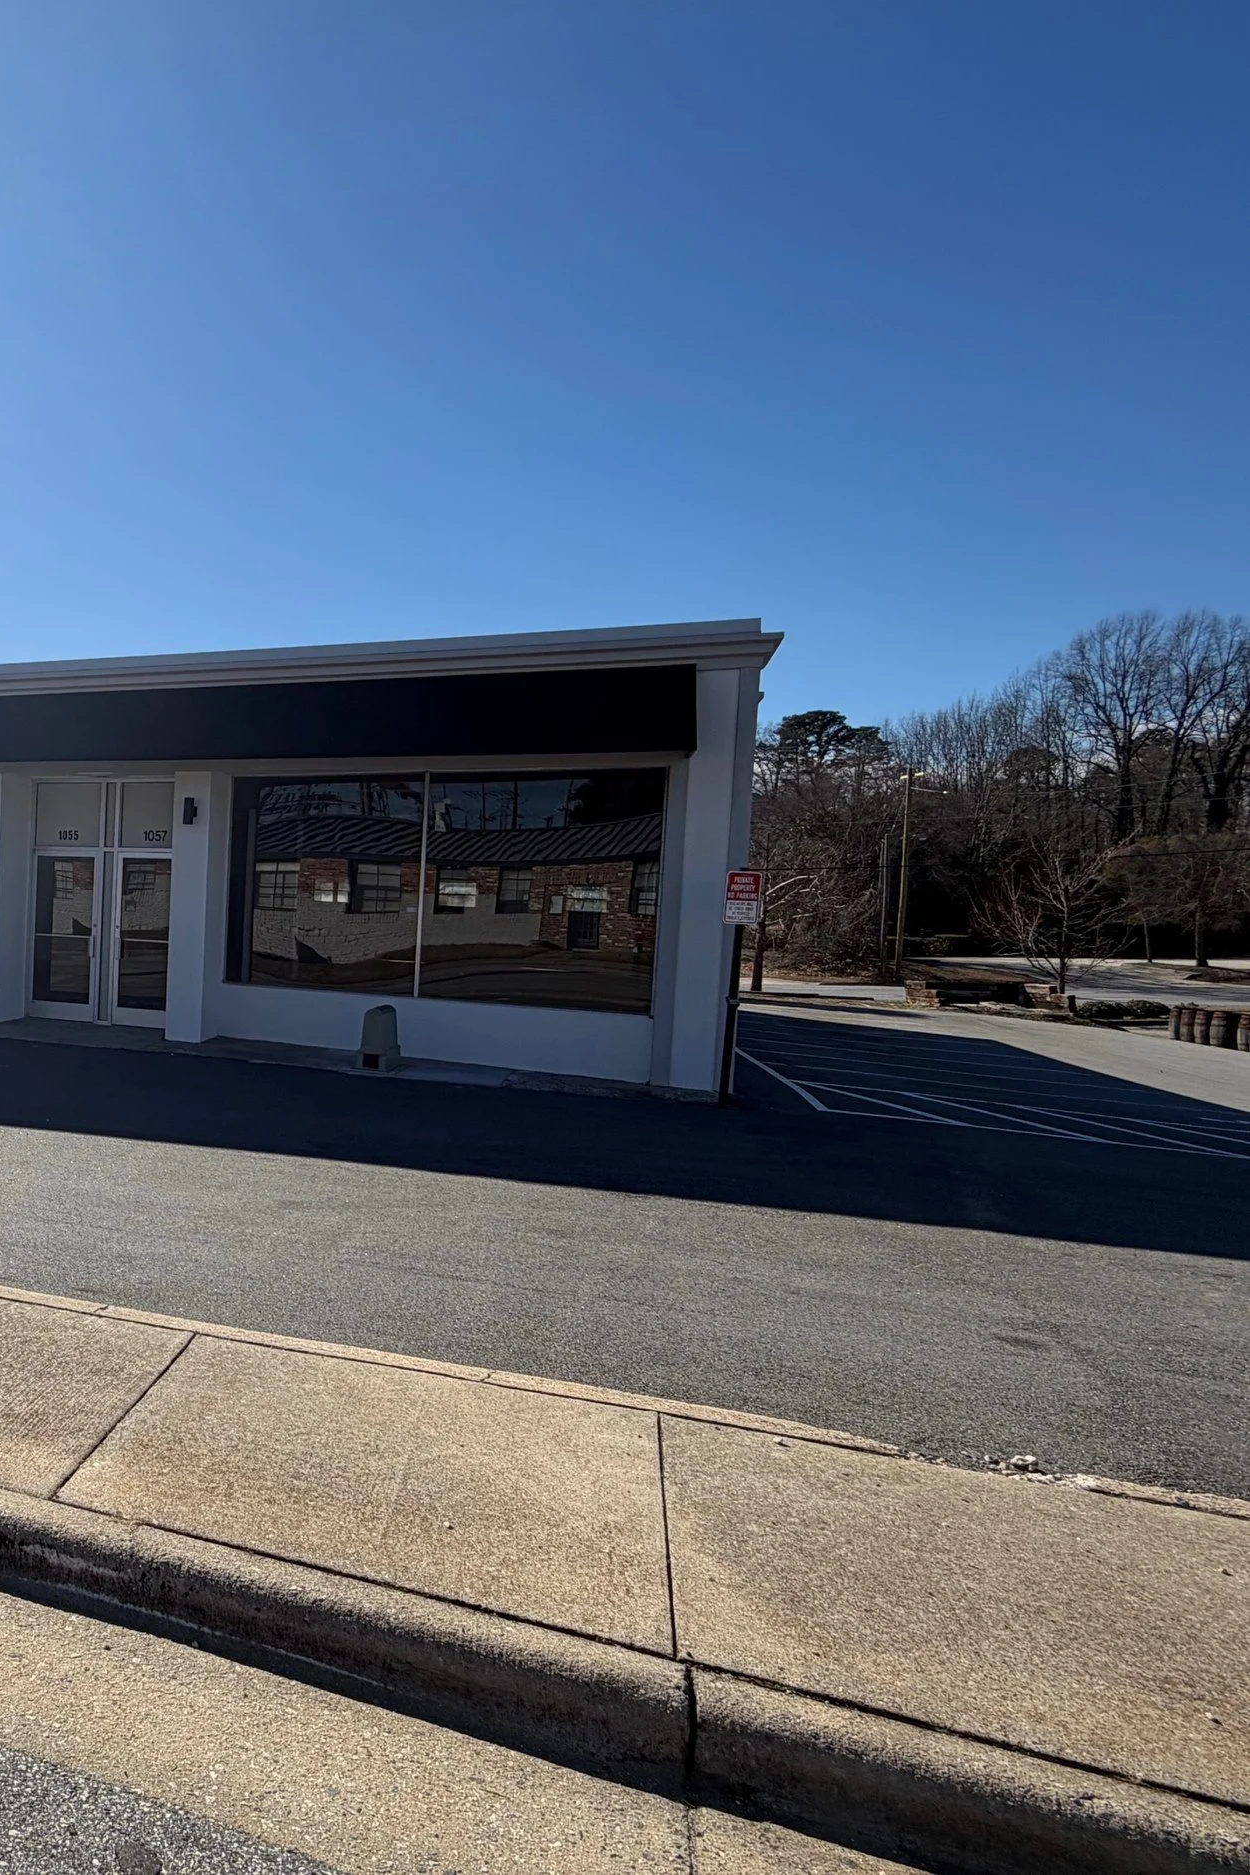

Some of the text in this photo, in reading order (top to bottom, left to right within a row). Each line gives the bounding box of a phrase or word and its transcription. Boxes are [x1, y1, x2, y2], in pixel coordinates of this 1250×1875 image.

[58, 830, 79, 841] 1055
[143, 830, 168, 842] 1057
[733, 876, 755, 884] PRIVATE
[730, 884, 756, 892] PROPERTY
[727, 891, 758, 900] NO PARKING
